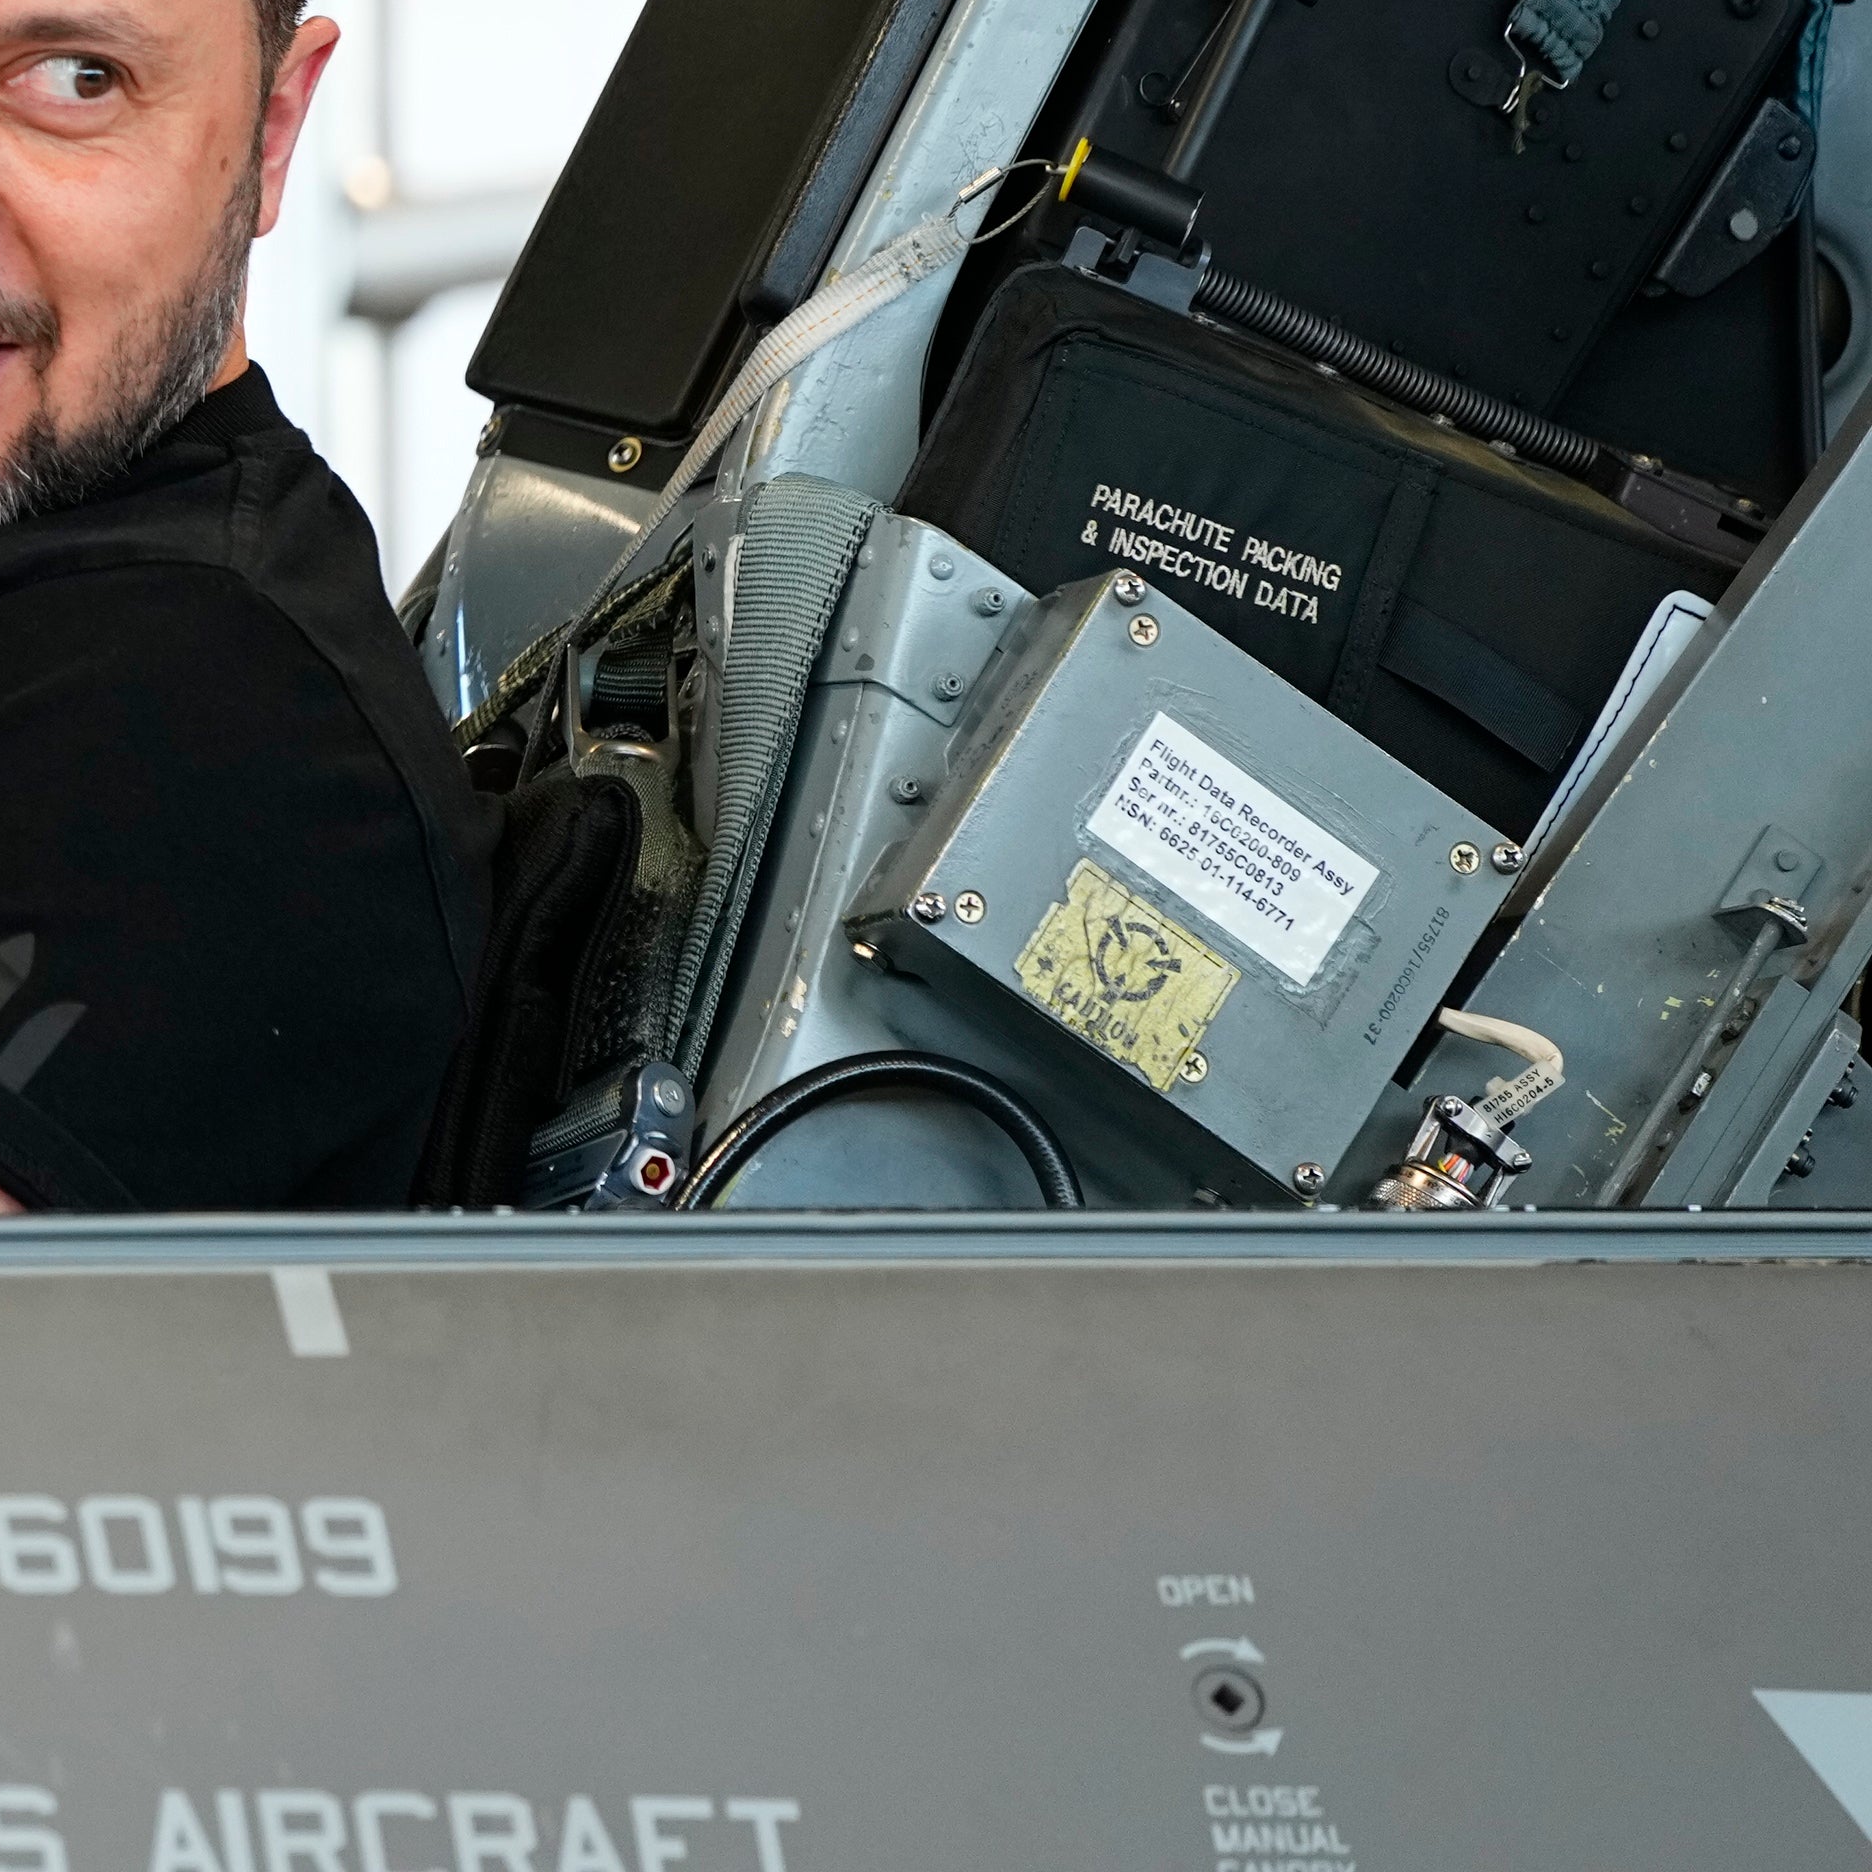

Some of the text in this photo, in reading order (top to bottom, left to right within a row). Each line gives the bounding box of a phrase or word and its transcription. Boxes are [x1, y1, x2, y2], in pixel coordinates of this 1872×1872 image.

[1081, 520, 1319, 624] & INSPECTION DATA
[1090, 483, 1342, 591] PARACHUTE PACKING
[1114, 794, 1295, 931] NSN: 6625-01-114-6771
[1128, 776, 1284, 897] Ser nr.: 81755C0813
[1139, 758, 1301, 882] Partnr.: 16C0200-809
[1150, 739, 1355, 897] Flight Data Recorder Assy
[1483, 1068, 1541, 1113] 81755 ASSY
[1158, 1574, 1255, 1607] OPEN
[148, 1787, 802, 1872] AIRCRAFT
[1203, 1783, 1325, 1818] CLOSE
[1212, 1824, 1352, 1855] MANUAL
